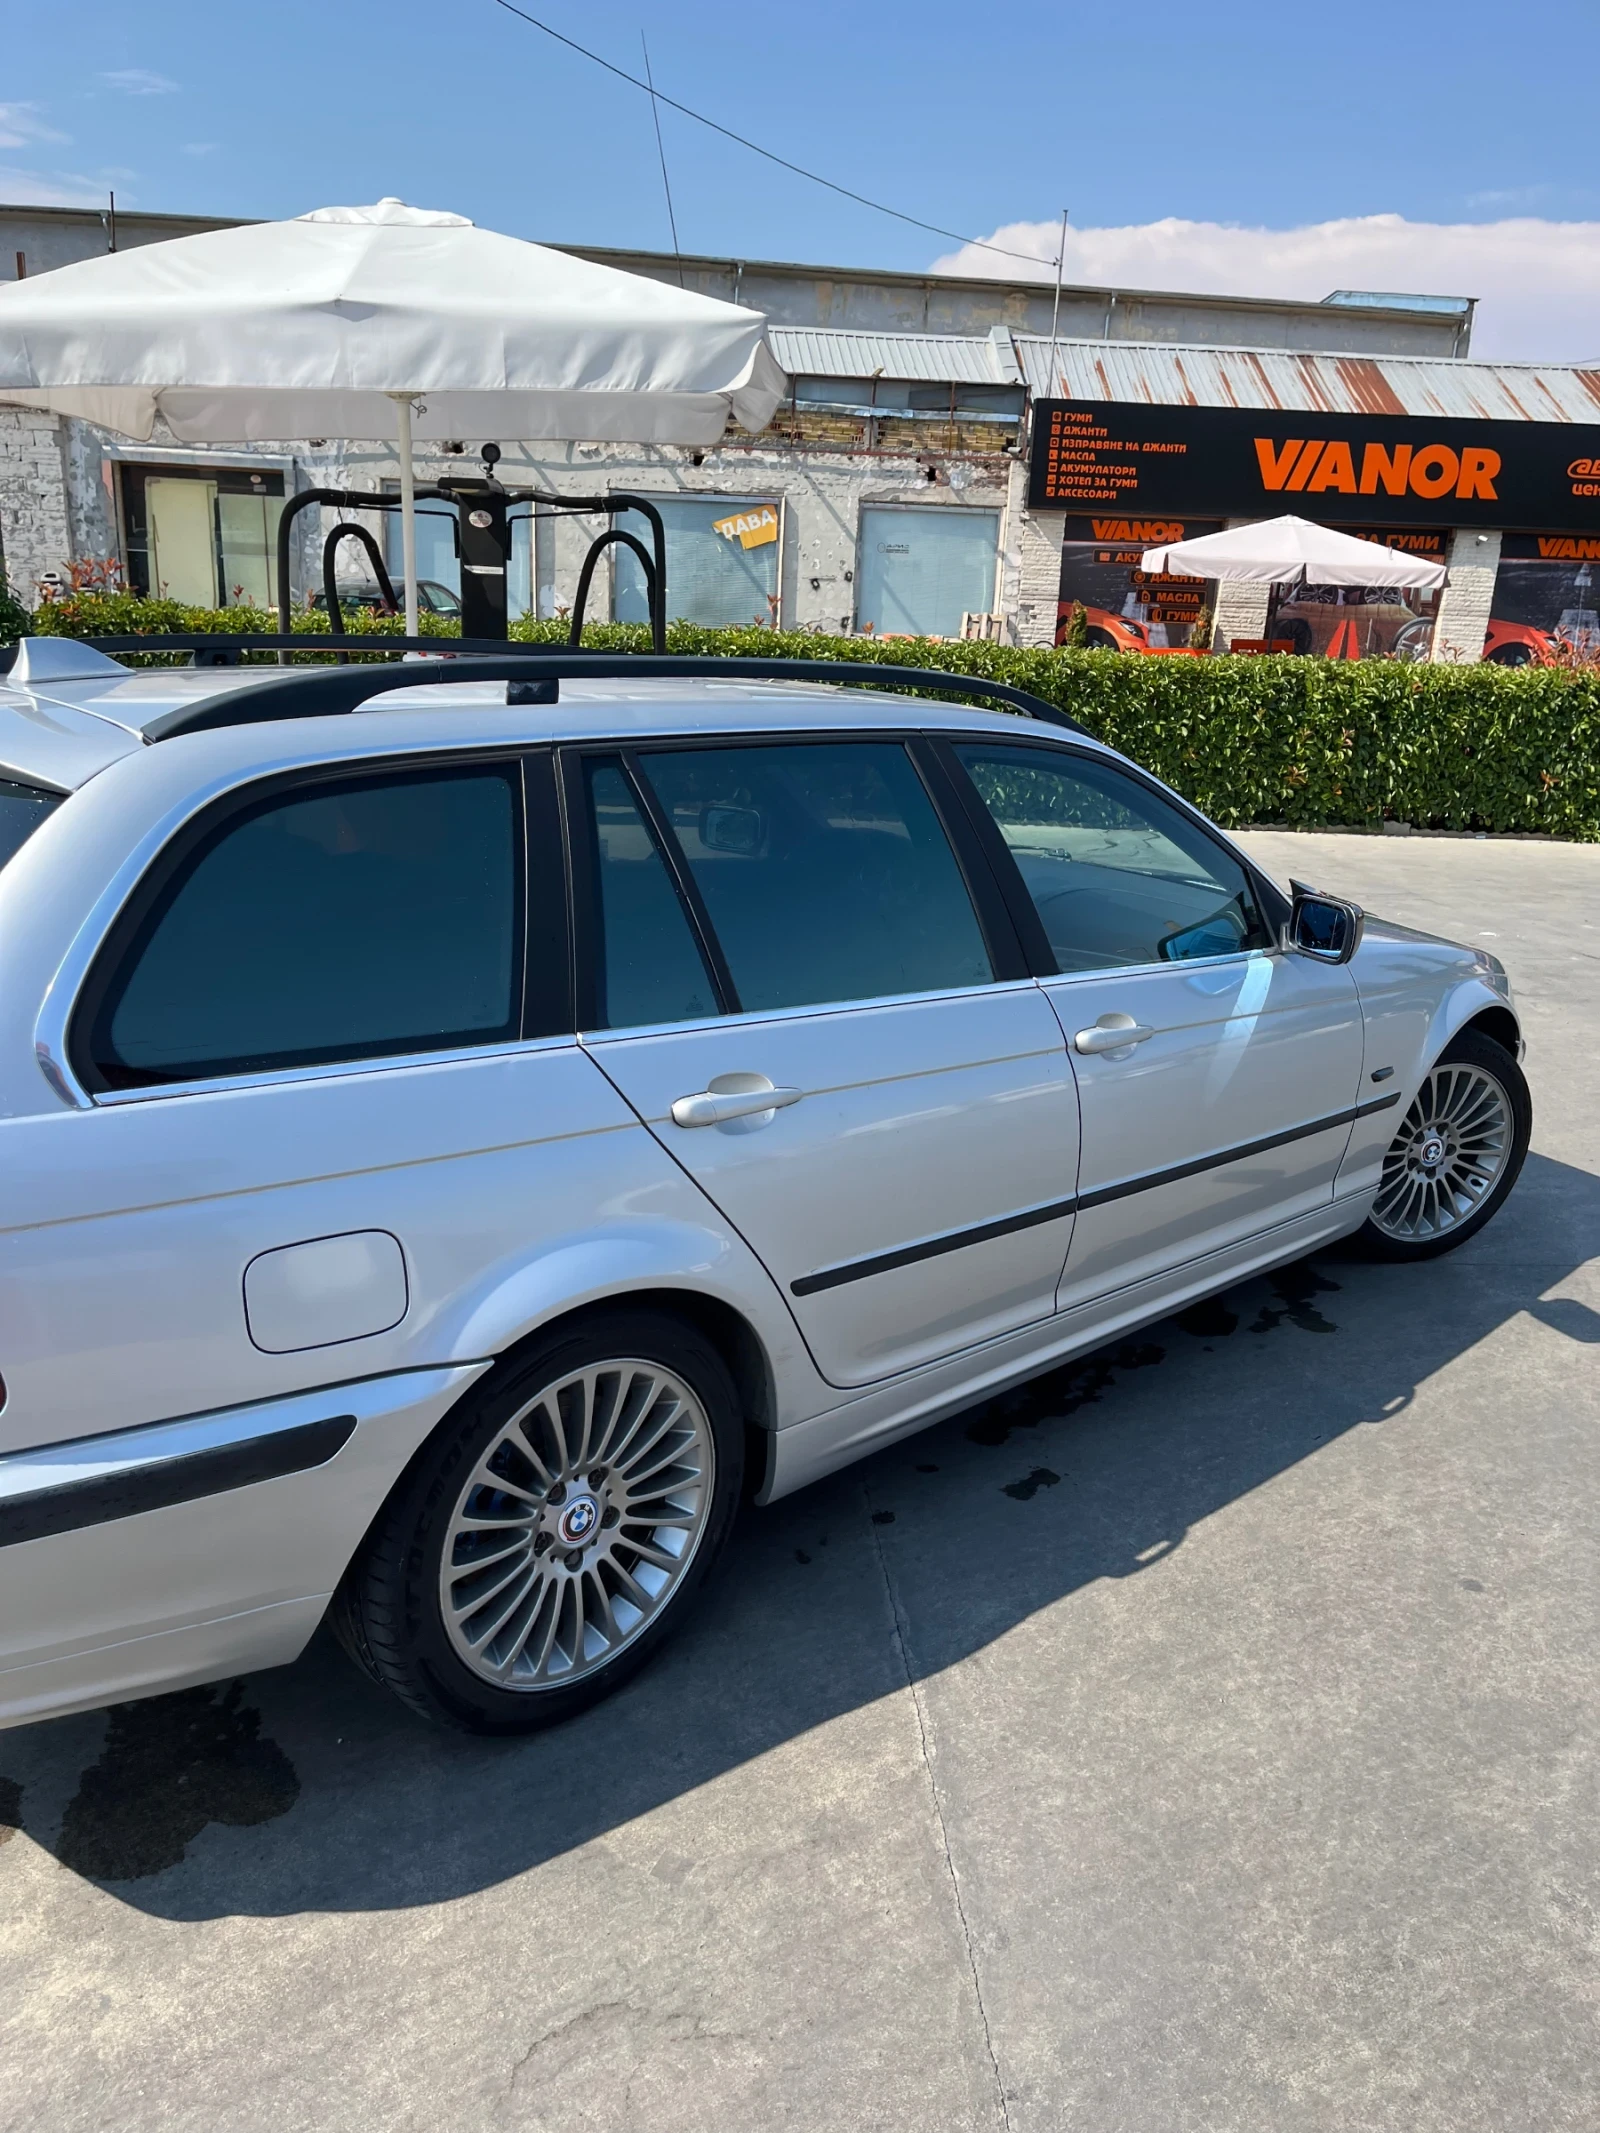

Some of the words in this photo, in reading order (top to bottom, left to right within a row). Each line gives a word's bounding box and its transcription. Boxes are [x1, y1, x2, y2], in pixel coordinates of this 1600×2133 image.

[1064, 412, 1093, 423] ГУМИ
[1063, 425, 1108, 437] ДЖАНТИ
[1062, 438, 1123, 450] ИЗПРАВЯНЕ
[1125, 441, 1140, 451] НА
[1142, 443, 1187, 453] ДЖАНТИ
[1060, 451, 1096, 461] МАСЛА
[1060, 463, 1137, 476] АКУМУЛАТОРИ
[1254, 438, 1501, 499] VIANOR
[1058, 475, 1092, 486] ХОТЕЛ
[1094, 477, 1107, 487] ЗА
[1109, 478, 1138, 488] ГУМИ
[1057, 489, 1117, 499] АКСЕСОАРИ
[1091, 519, 1185, 542] VIANOR
[1385, 534, 1440, 551] ГУМИ
[1537, 537, 1600, 559] VIAN
[1156, 592, 1200, 604] МАСЛА
[1166, 609, 1200, 622] ГУМИ
